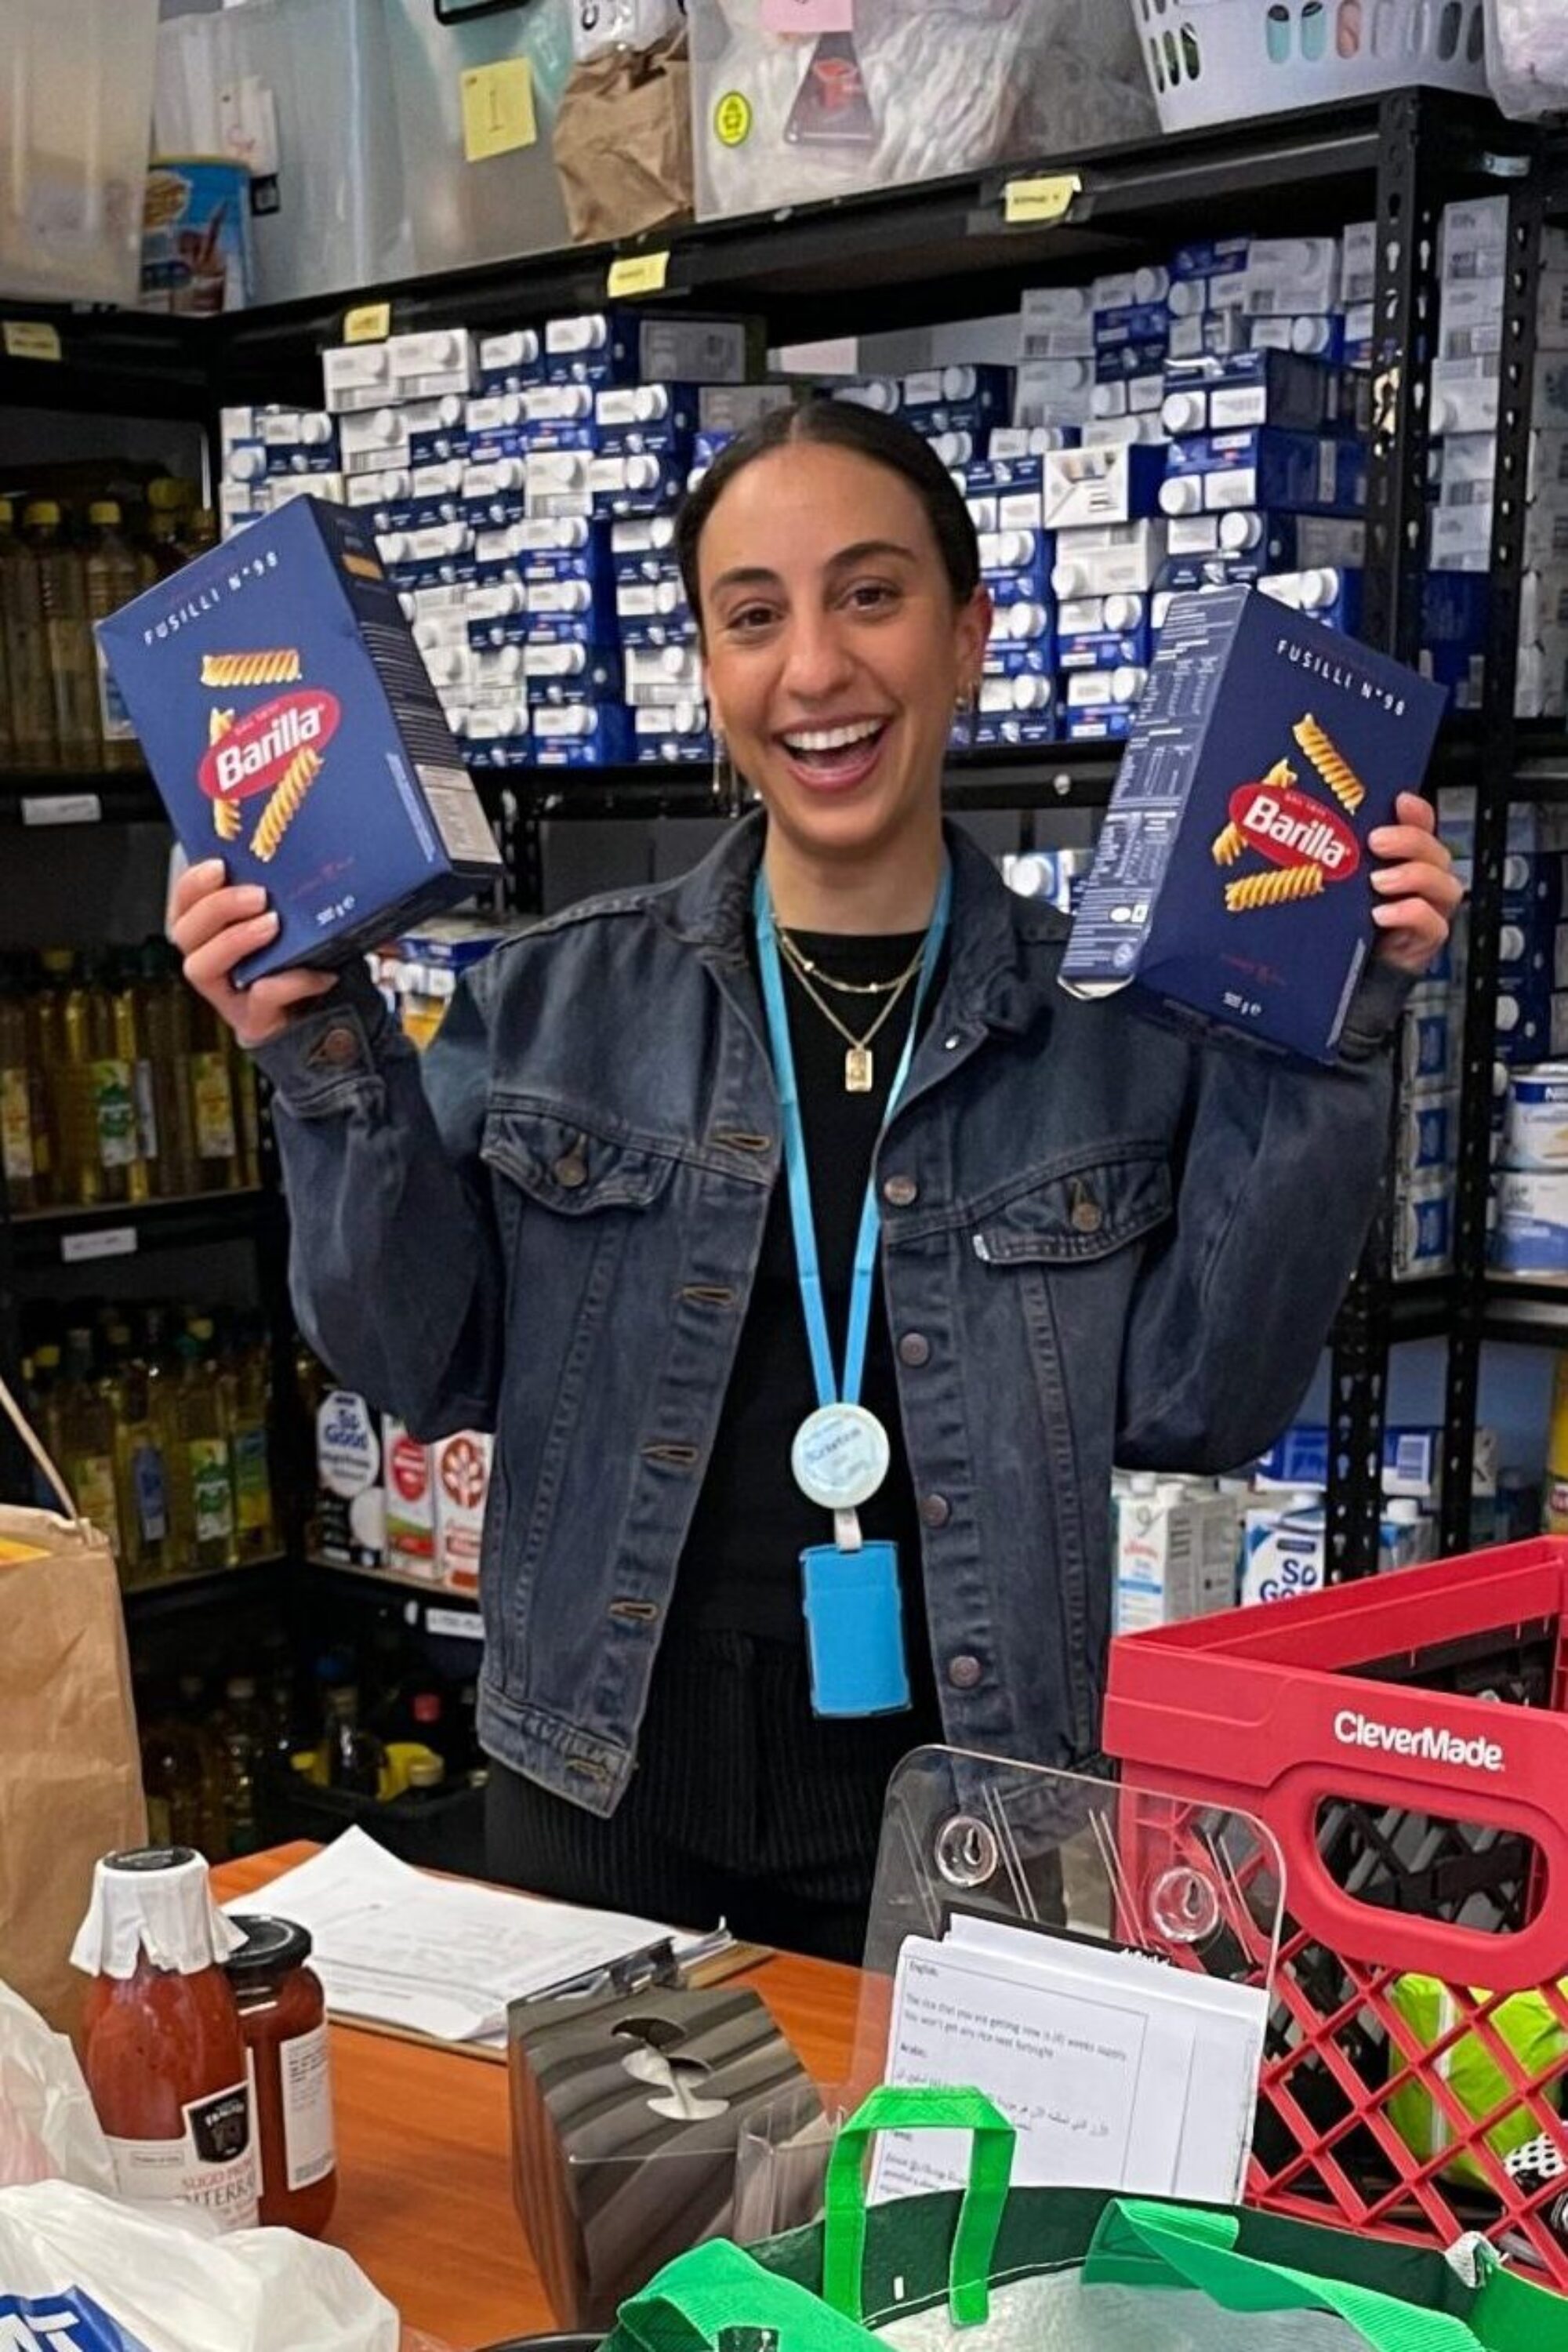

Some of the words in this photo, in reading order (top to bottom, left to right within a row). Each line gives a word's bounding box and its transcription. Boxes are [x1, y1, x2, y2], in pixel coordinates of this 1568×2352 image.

[143, 587, 220, 646] FUSILLI
[1276, 639, 1352, 689] FUSILLI
[216, 706, 321, 792] Barilla
[1243, 793, 1347, 869] Barilla
[1281, 1558, 1318, 1587] So
[1334, 1710, 1504, 1771] CleverMade
